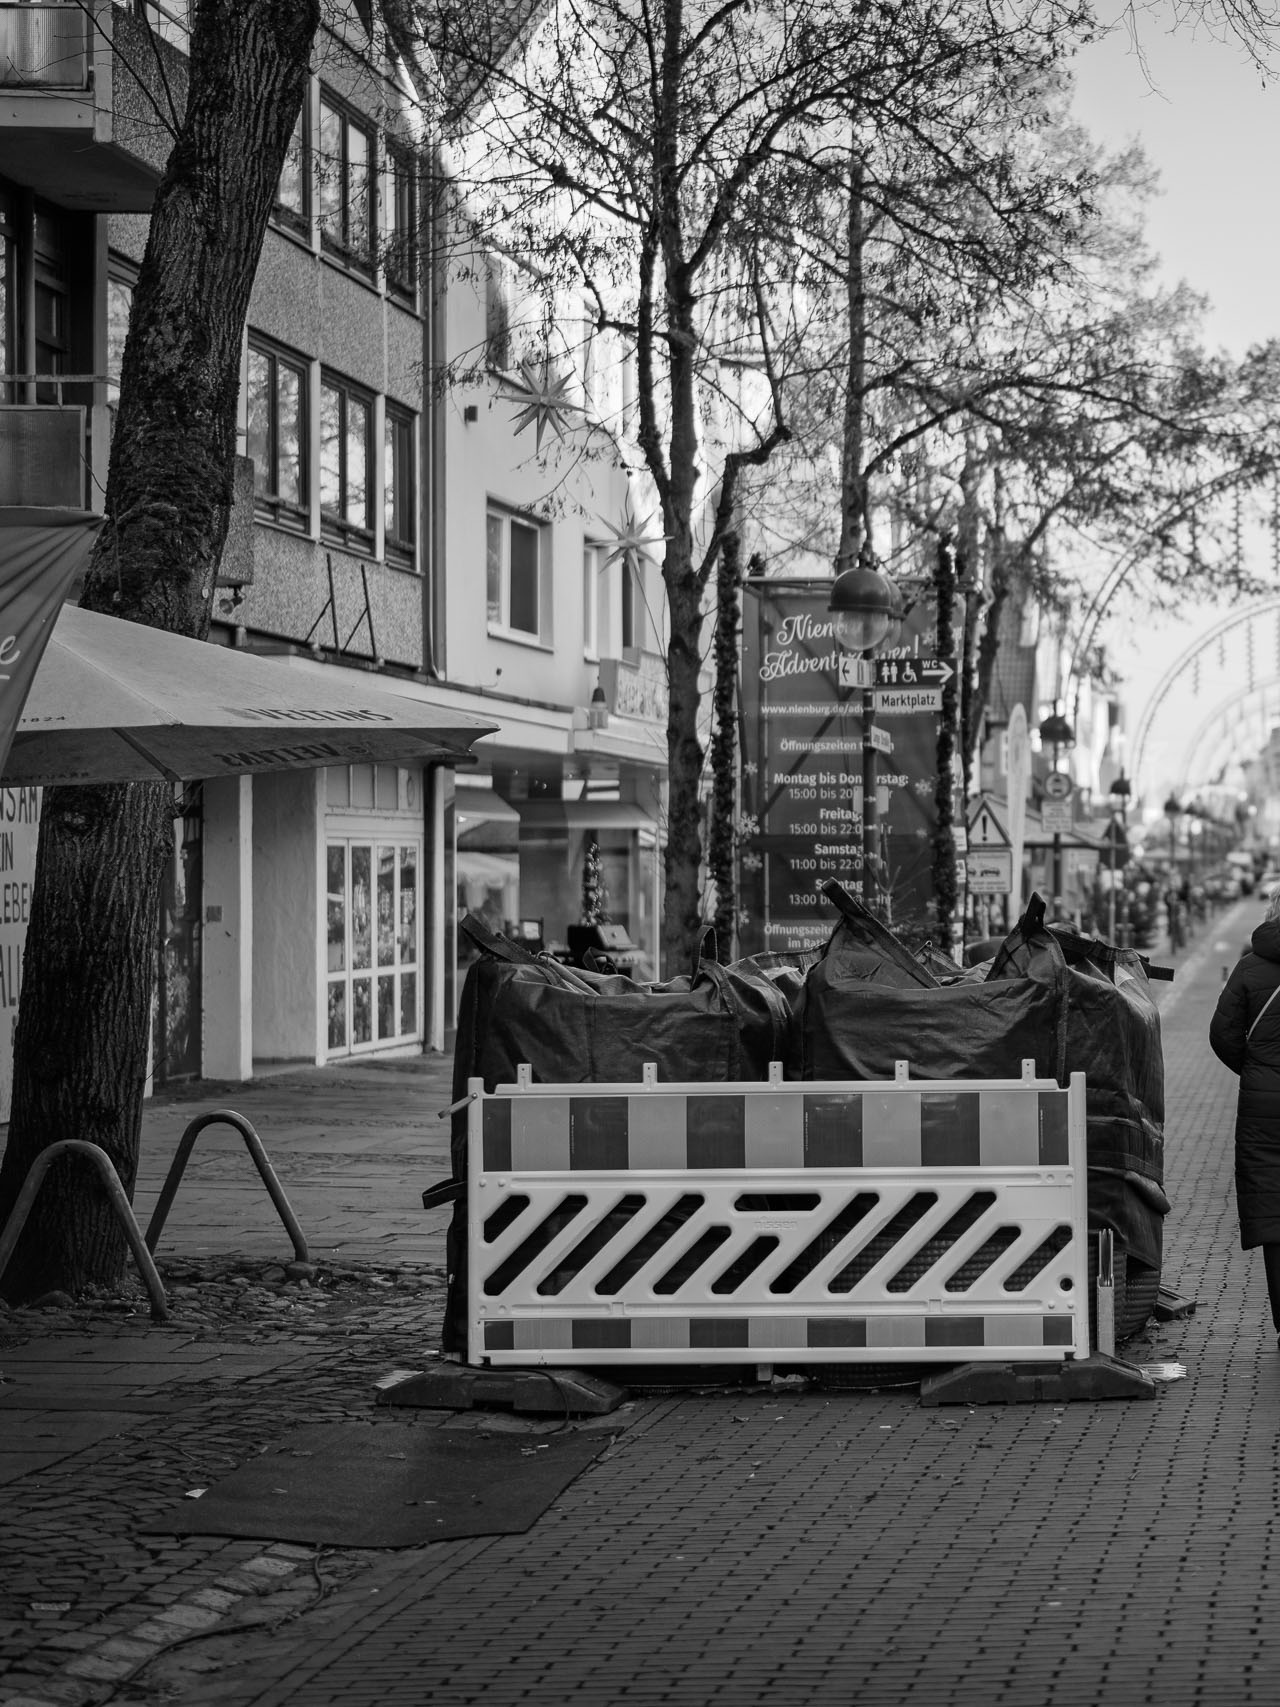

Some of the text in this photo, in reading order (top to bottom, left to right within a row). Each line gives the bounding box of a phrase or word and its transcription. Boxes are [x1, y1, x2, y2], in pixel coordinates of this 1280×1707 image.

[922, 660, 938, 669] WC
[881, 693, 936, 709] Marktplatz
[243, 708, 394, 721] VELTINS
[780, 738, 859, 753] Öffnungszeiten
[774, 772, 909, 787] Montag bis Donrstag:
[788, 788, 817, 799] 15:00
[820, 788, 836, 799] bis
[789, 823, 862, 834] 15:00 bis 22:0
[790, 859, 862, 870] 11:00 bis 22:0
[789, 894, 817, 905] 13:00
[764, 922, 834, 936] Öffnungszeite
[788, 938, 801, 948] im
